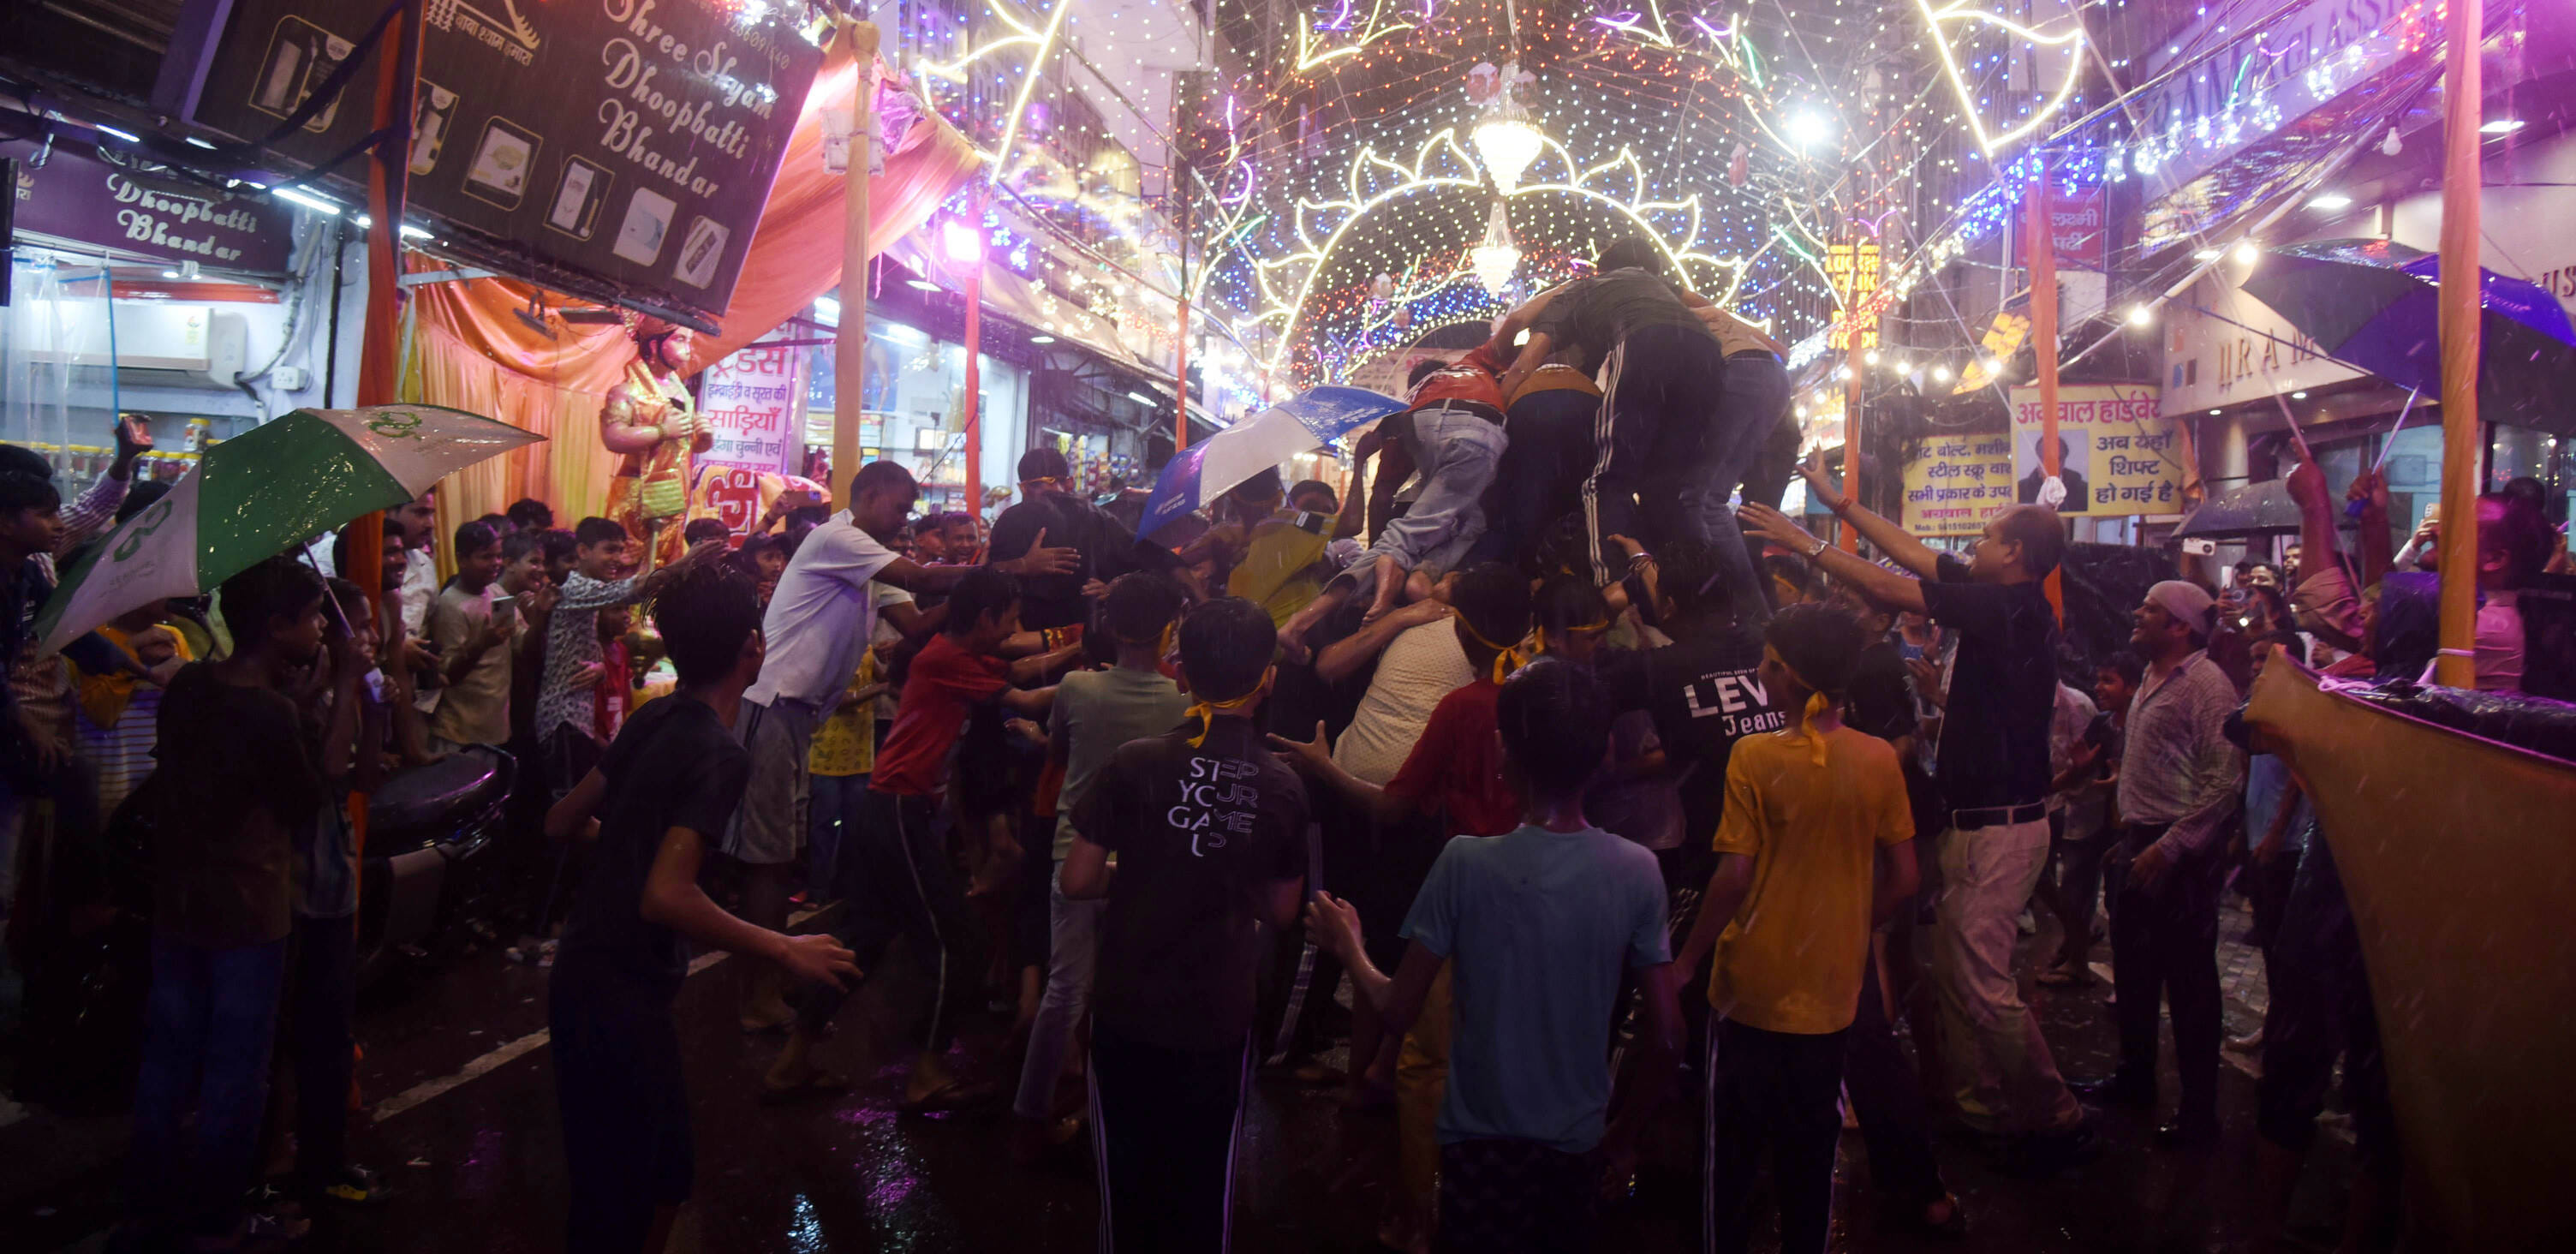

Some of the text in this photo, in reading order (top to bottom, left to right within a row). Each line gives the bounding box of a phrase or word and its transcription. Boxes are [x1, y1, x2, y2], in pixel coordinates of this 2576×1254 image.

[602, 38, 751, 160] Dhoopbatti
[599, 98, 719, 200] Bhandar
[107, 173, 257, 233] Dhoopbatti
[117, 209, 242, 261] Bhandar
[2096, 435, 2131, 451] अब
[2109, 456, 2160, 475] शिफ्ट
[1908, 485, 1934, 502] सभी
[1936, 488, 1971, 502] प्रकार
[1972, 483, 1985, 498] के
[2096, 480, 2174, 504] हो गई है
[1190, 756, 1259, 782] STEP
[1167, 805, 1256, 833] GAME
